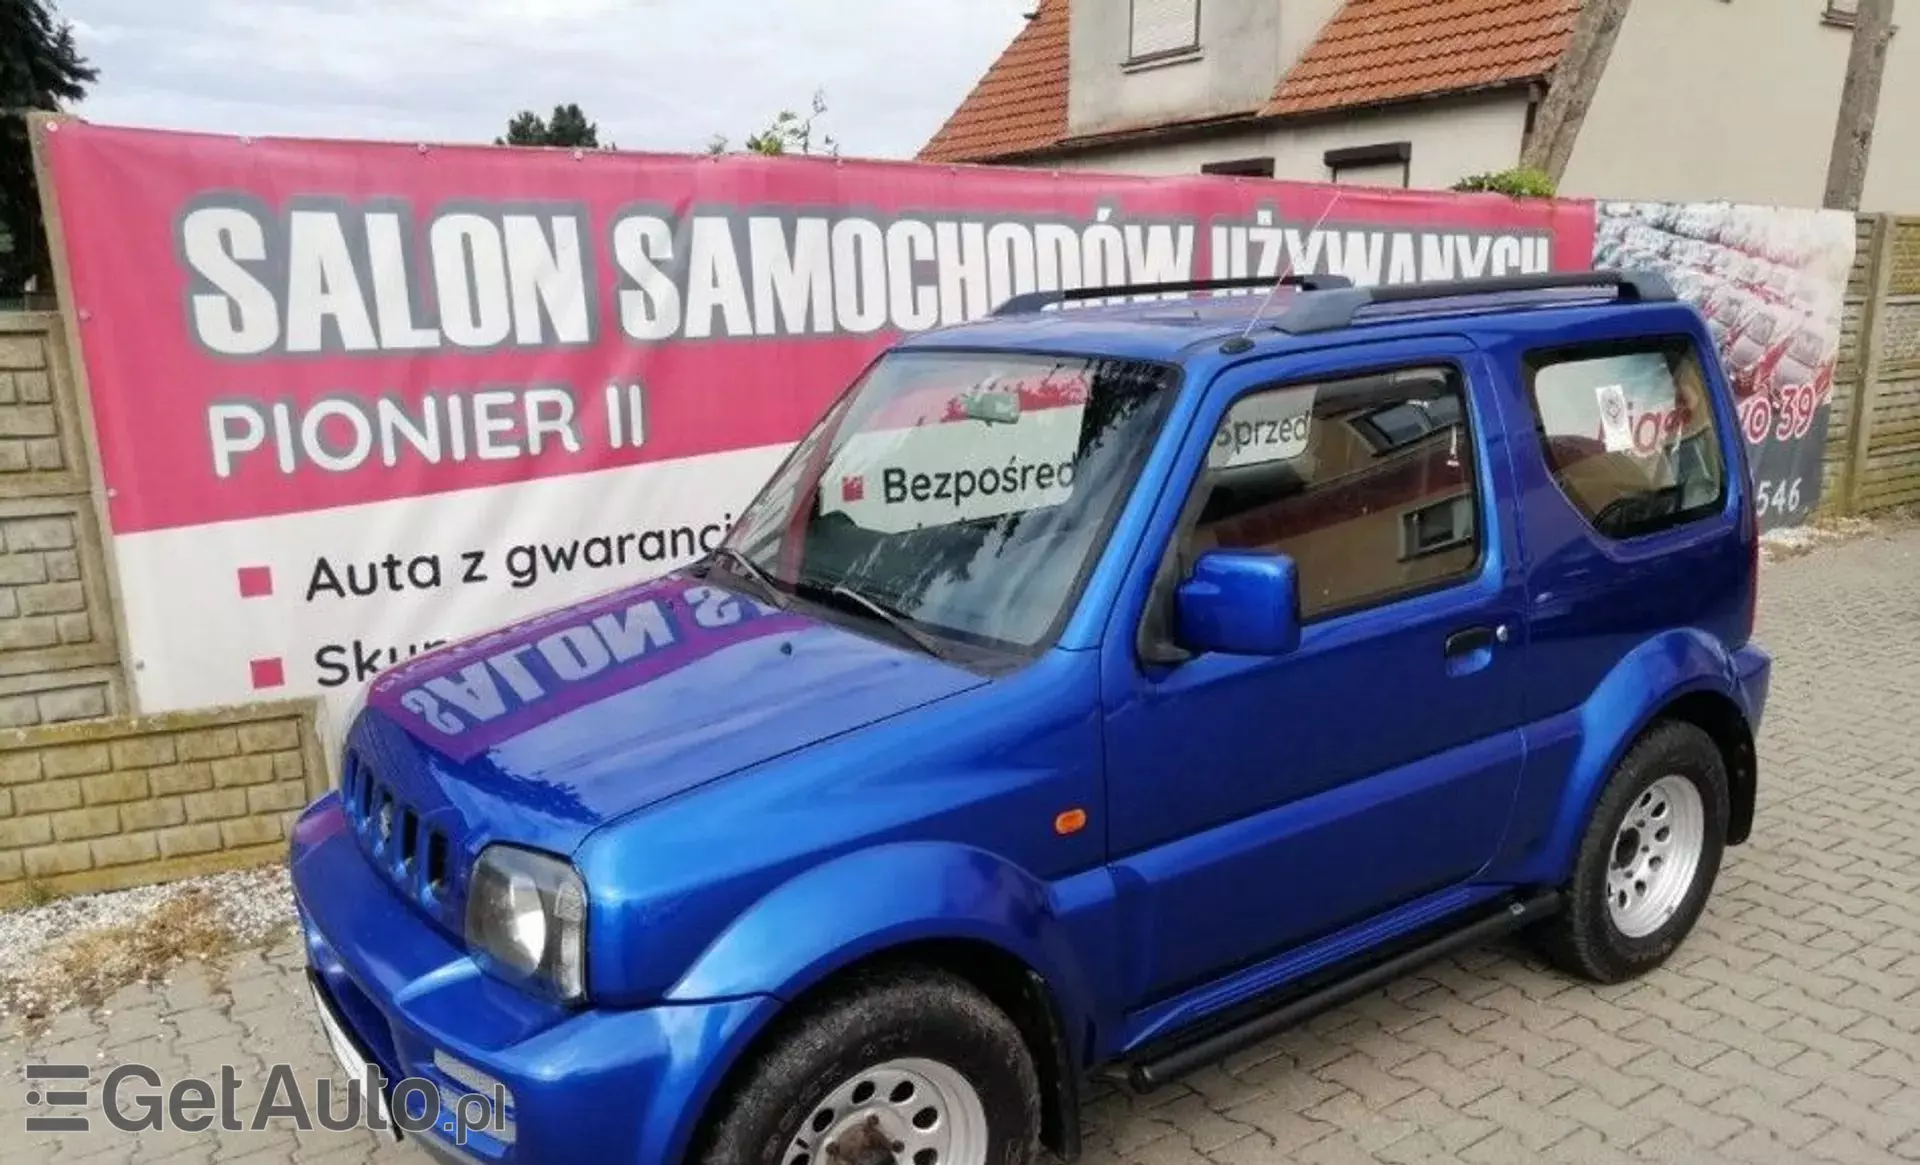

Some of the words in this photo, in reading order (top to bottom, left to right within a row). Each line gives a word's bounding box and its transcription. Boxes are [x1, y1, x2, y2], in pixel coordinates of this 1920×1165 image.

[183, 207, 591, 354] SALON
[613, 207, 1195, 341] SAMOCHODÓW
[208, 388, 581, 478] PIONIER
[605, 383, 644, 450] II
[1755, 477, 1802, 518] 546
[306, 554, 441, 602] Auta
[460, 549, 489, 584] z
